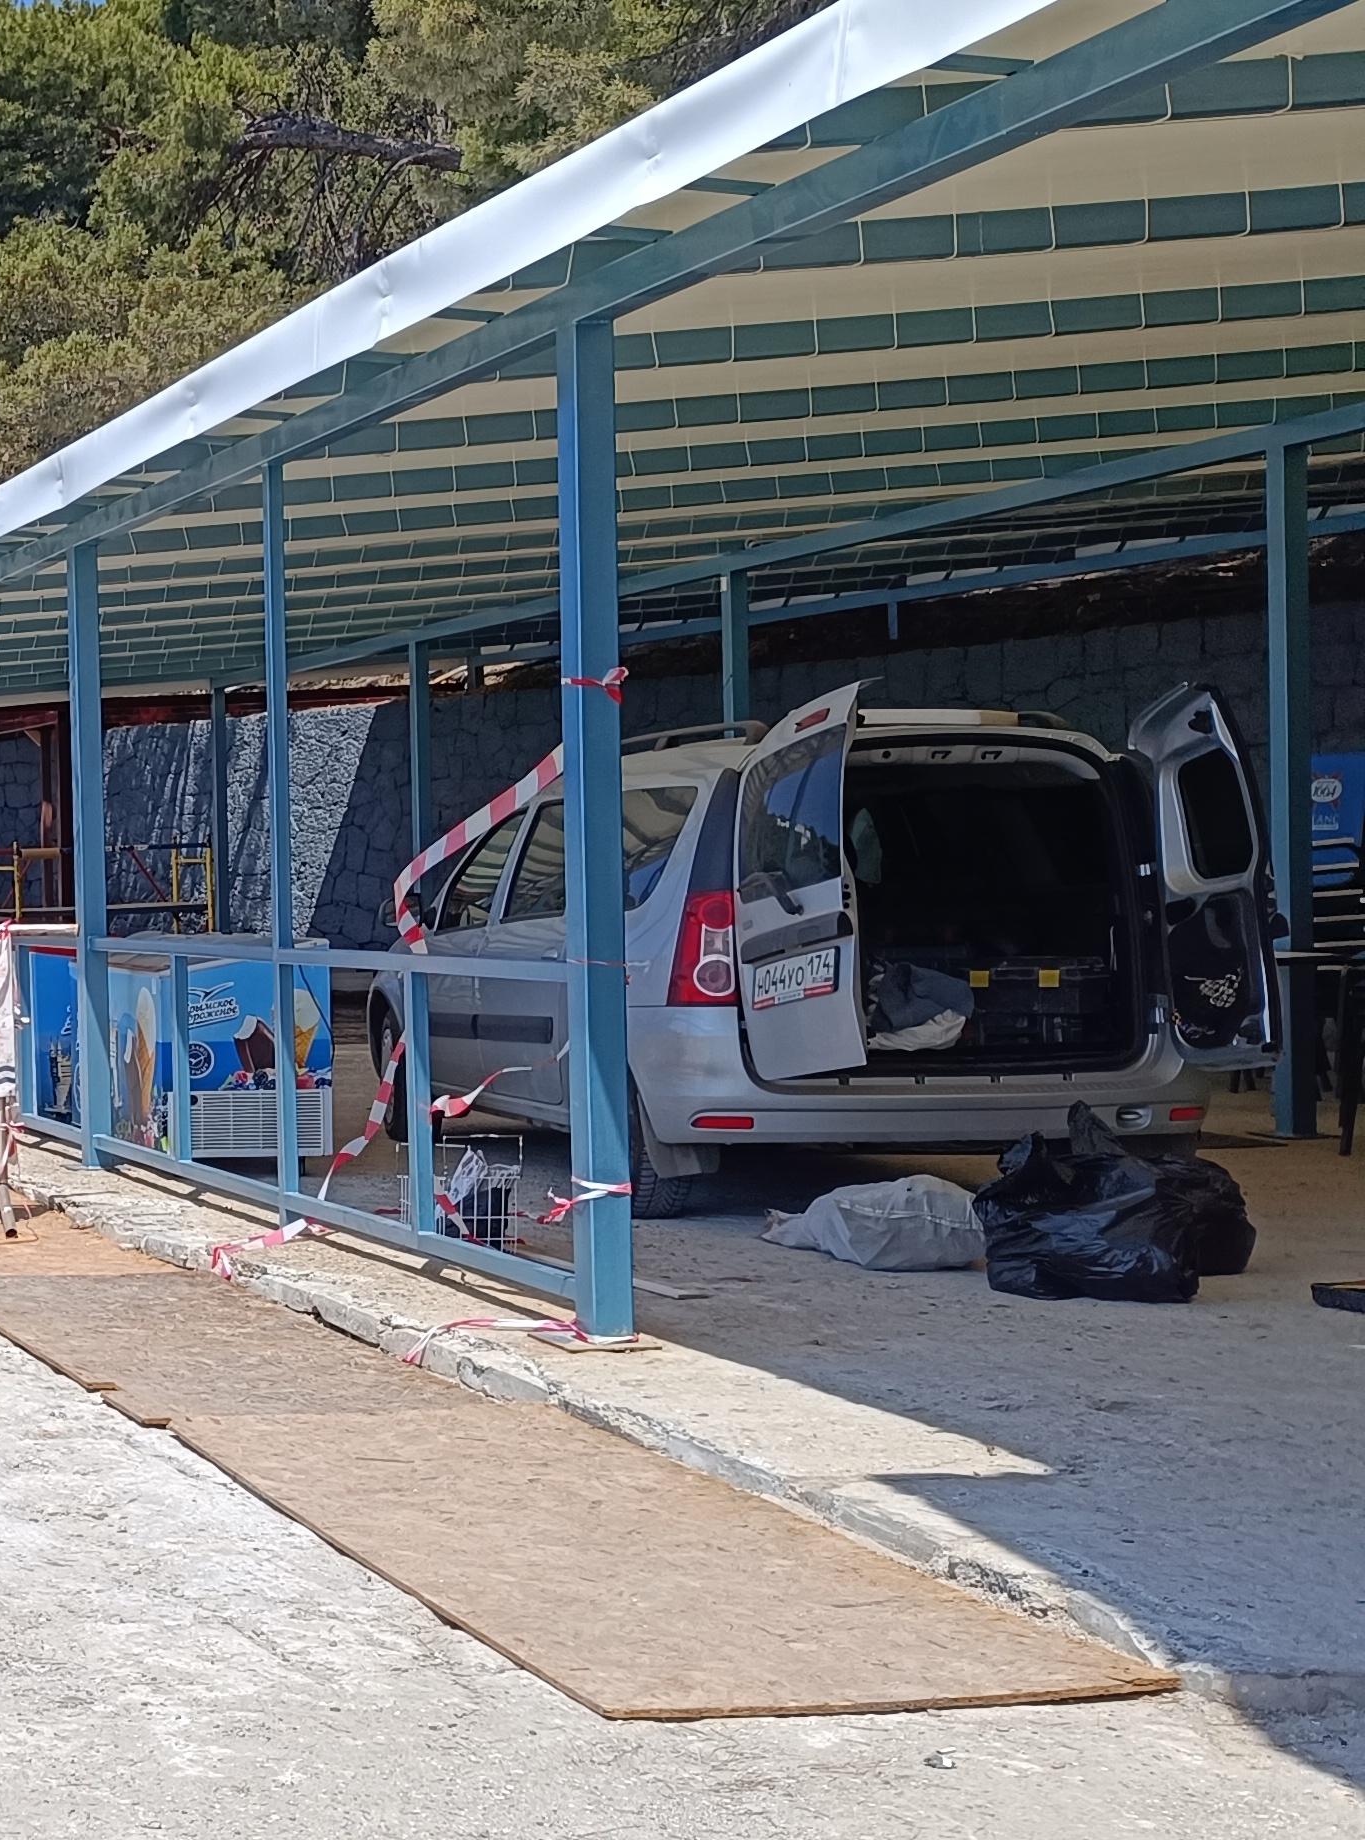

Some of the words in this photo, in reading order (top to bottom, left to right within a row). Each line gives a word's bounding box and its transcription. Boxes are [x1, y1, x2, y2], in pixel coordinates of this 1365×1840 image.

[807, 952, 831, 977] 174
[188, 998, 234, 1013] рымское
[188, 1006, 238, 1024] роженое
